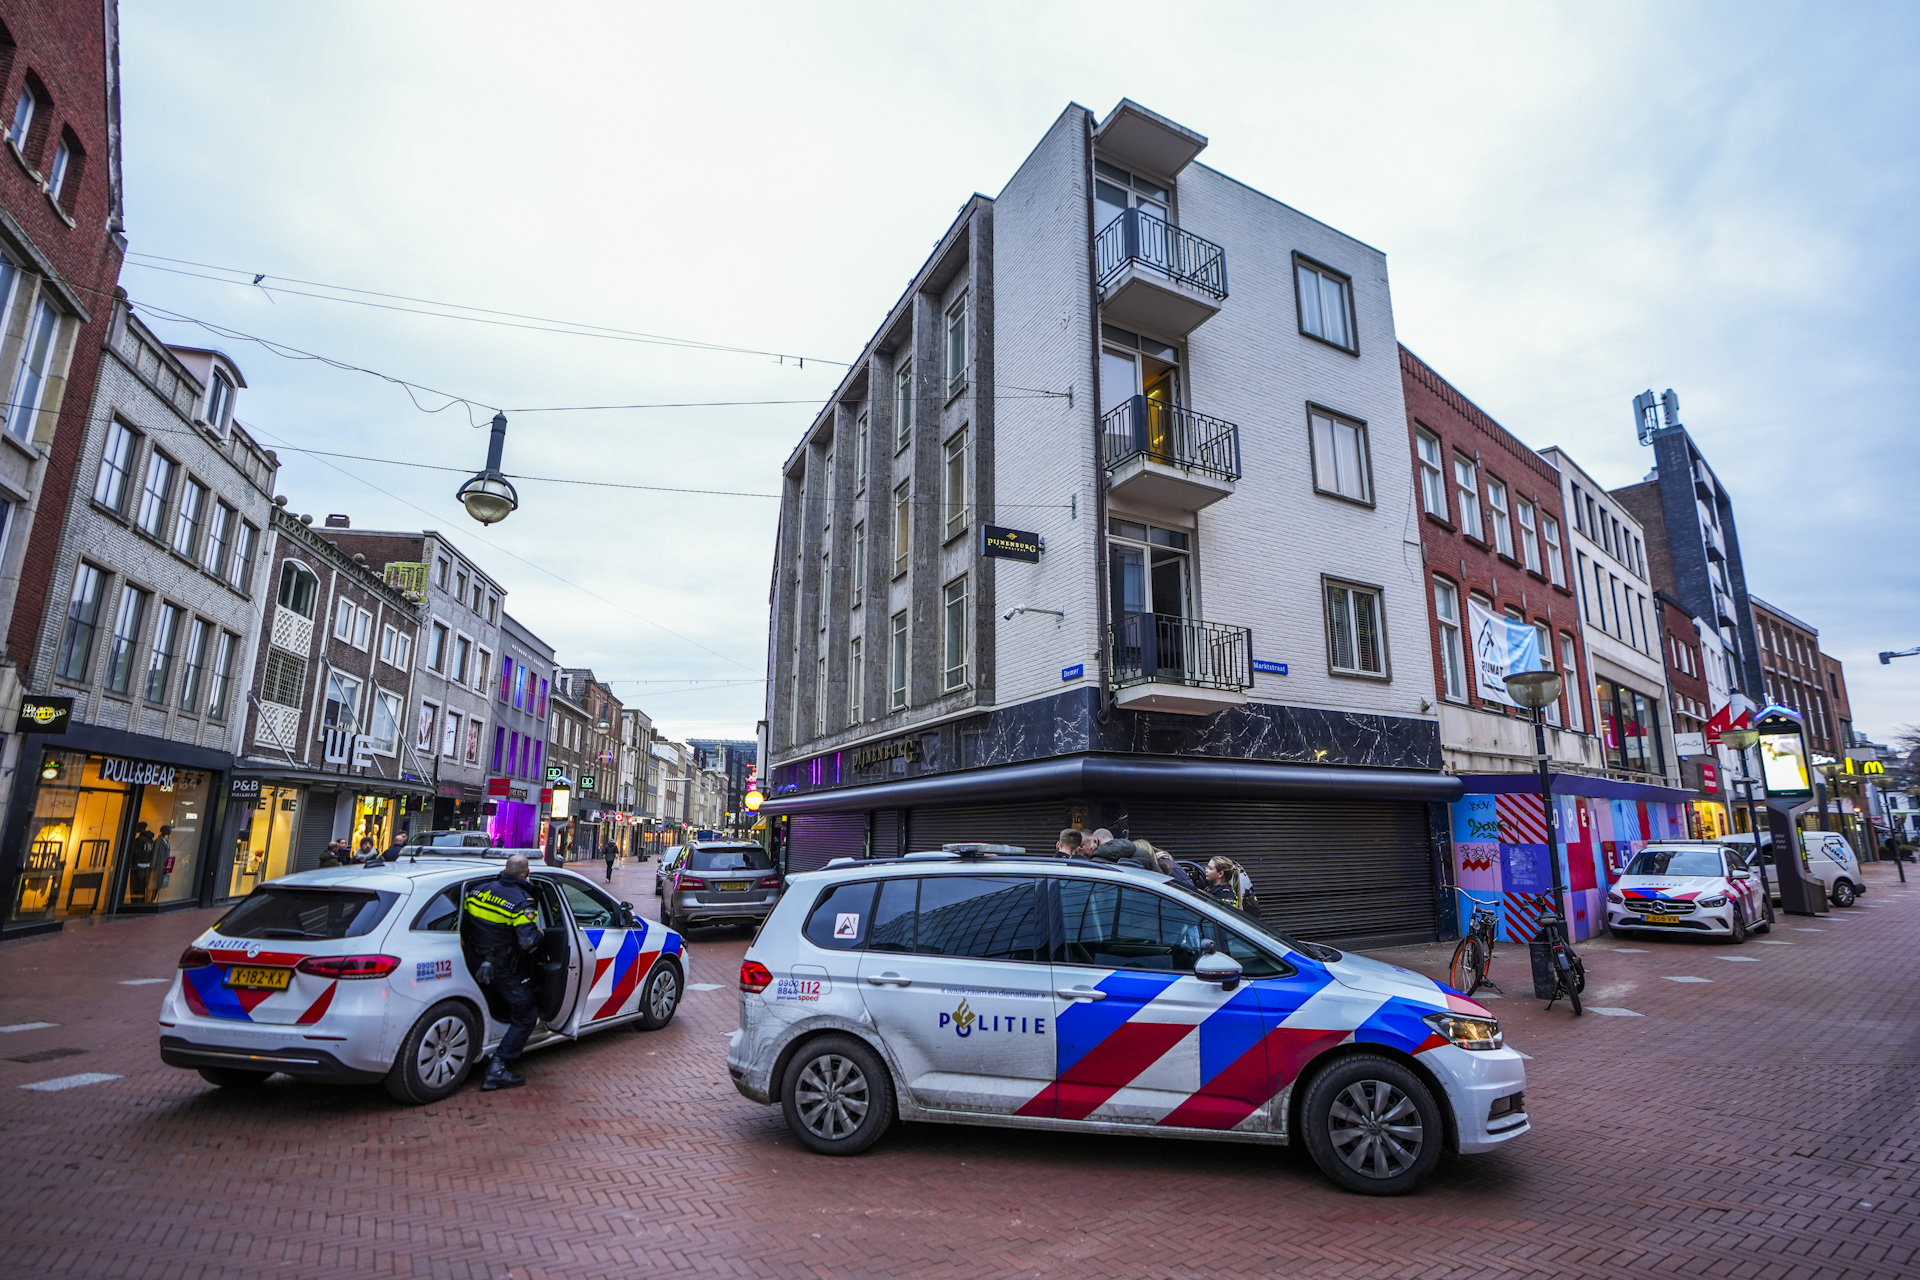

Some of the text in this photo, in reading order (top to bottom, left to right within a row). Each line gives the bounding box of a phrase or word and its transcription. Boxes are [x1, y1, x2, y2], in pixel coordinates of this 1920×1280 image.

[987, 538, 1036, 552] PIJNENBURG
[1063, 668, 1079, 677] Demer
[1253, 661, 1286, 672] Marktstraat
[325, 729, 374, 767] WE
[852, 740, 914, 774] PIJNENBURG
[103, 758, 176, 787] PULL&BEAR
[232, 780, 259, 791] P&B
[281, 798, 297, 811] WE
[207, 940, 251, 949] POLITIE
[416, 961, 435, 970] 0900
[435, 960, 452, 972] 112
[234, 968, 285, 985] X-182-KX
[416, 969, 435, 977] 8844
[778, 979, 800, 987] 0900
[800, 981, 821, 994] 112
[777, 987, 798, 995] 8844
[946, 987, 987, 996] waakzaam
[998, 989, 1040, 999] dienstbaar
[798, 994, 819, 1003] spoed
[939, 1012, 1045, 1038] POLITIE
